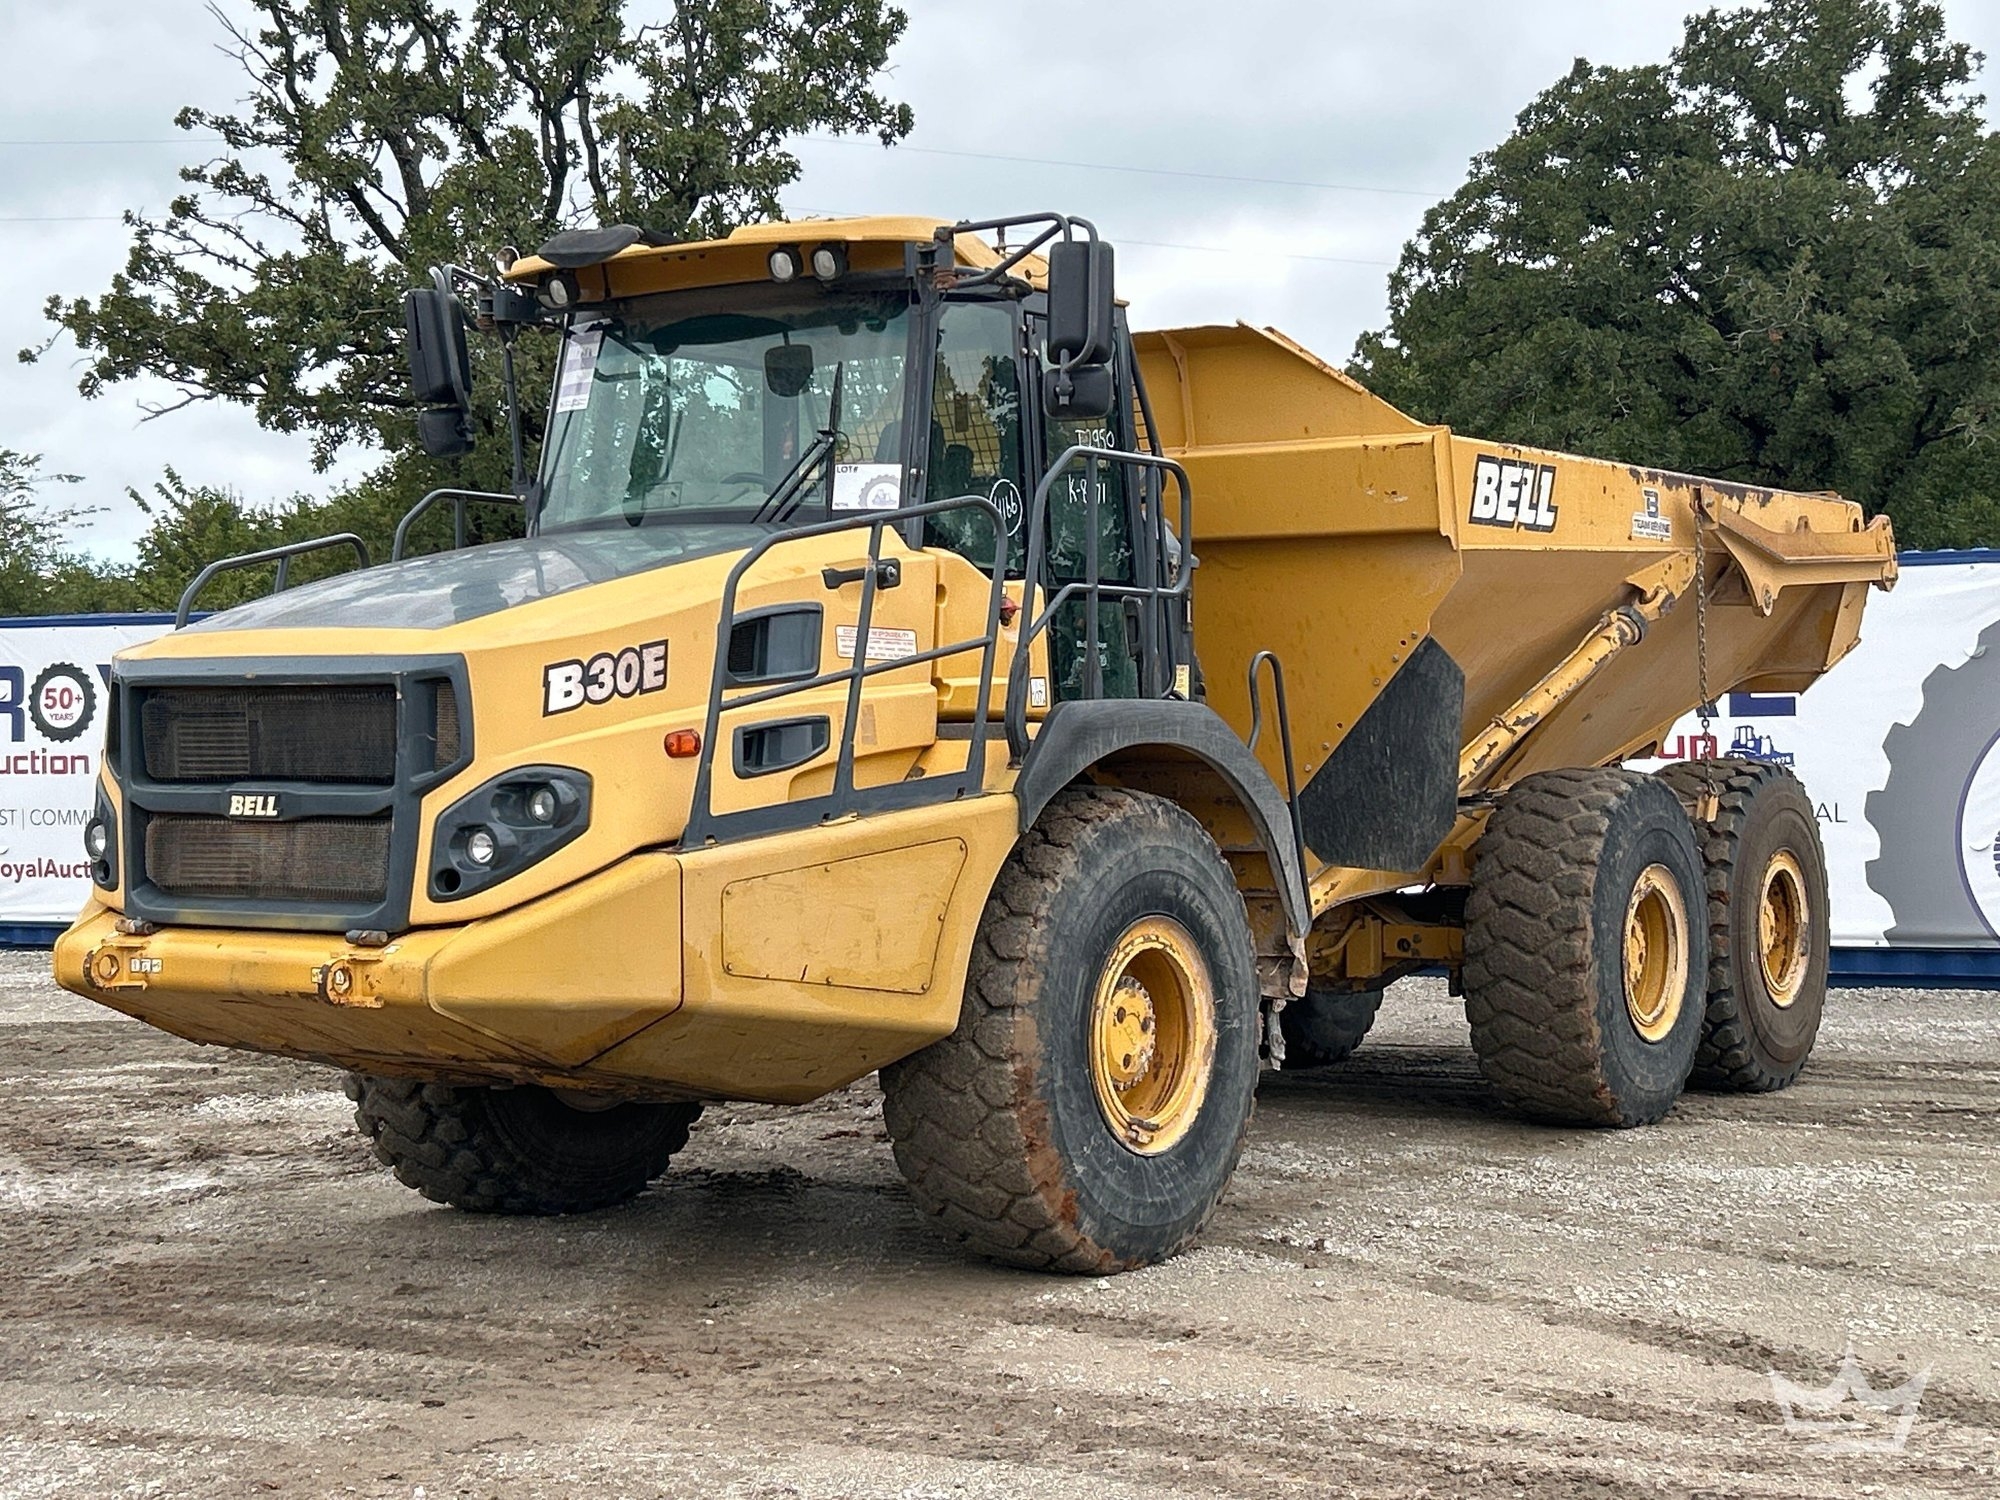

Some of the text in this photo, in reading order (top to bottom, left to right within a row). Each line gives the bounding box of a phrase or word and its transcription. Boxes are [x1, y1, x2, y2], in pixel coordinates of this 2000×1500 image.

[836, 465, 858, 473] LOT#
[1470, 455, 1558, 531] BELL
[542, 639, 668, 717] B30E
[44, 687, 83, 709] 50+
[49, 713, 74, 721] YEARS
[229, 795, 278, 816] BELL
